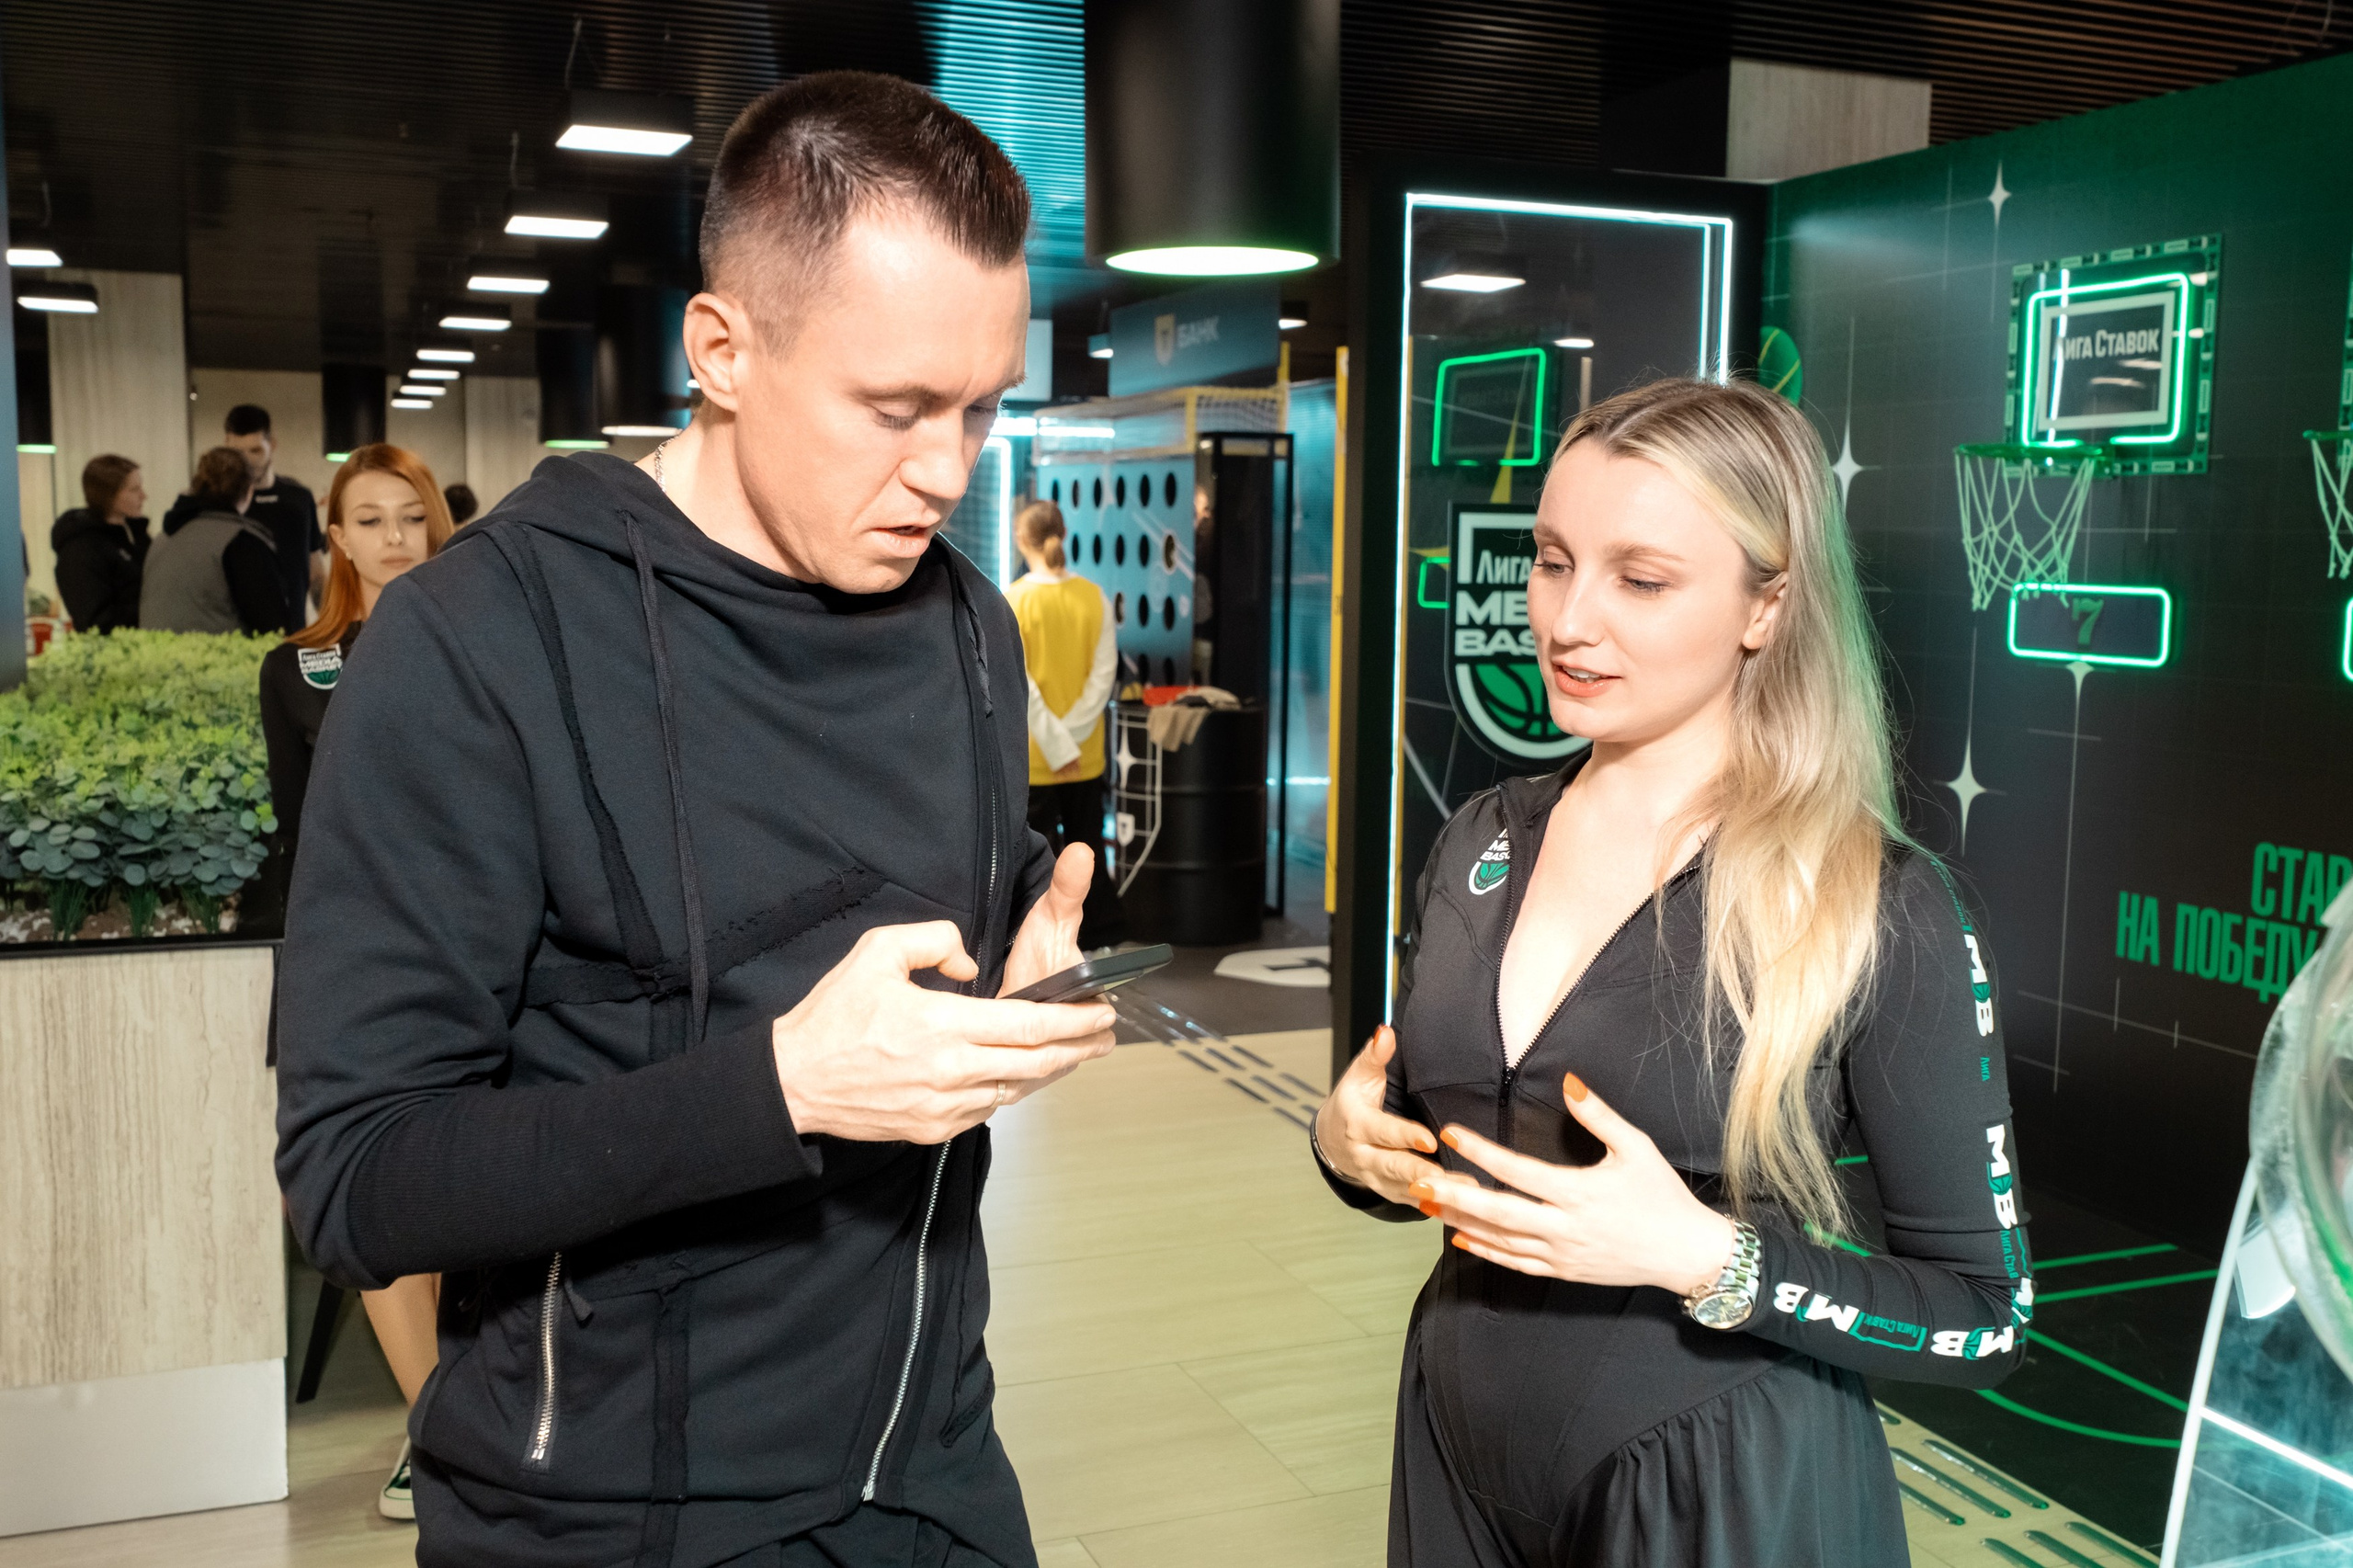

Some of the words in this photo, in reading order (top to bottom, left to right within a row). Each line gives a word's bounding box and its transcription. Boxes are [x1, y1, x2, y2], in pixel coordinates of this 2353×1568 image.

[1454, 629, 1538, 656] BAS
[2072, 597, 2104, 645] 7
[2116, 890, 2160, 967] НА
